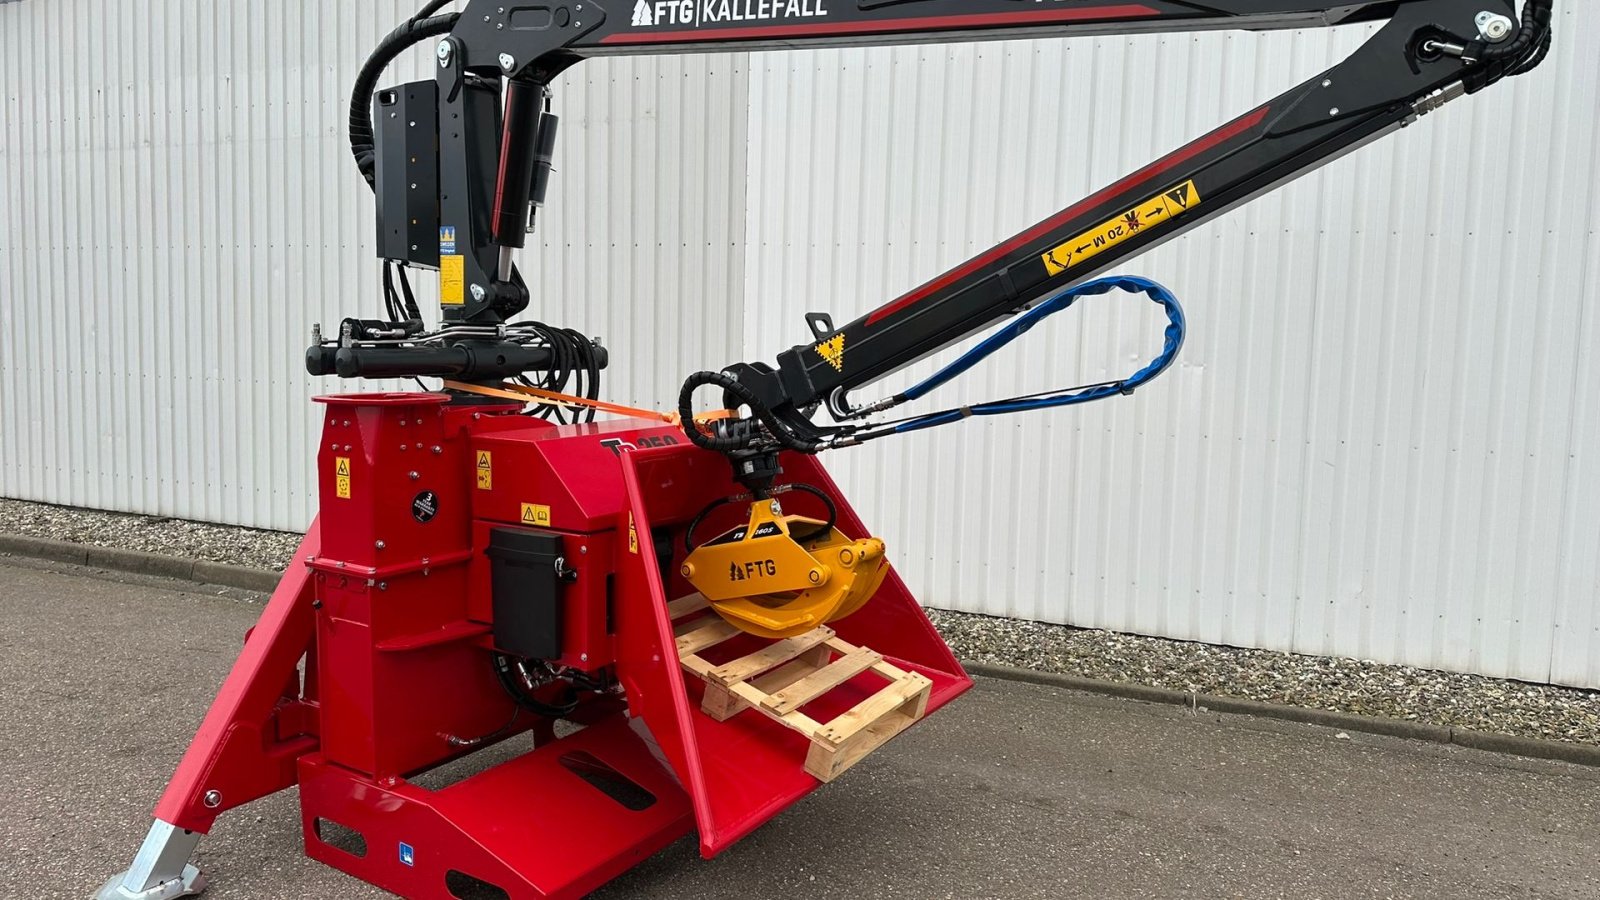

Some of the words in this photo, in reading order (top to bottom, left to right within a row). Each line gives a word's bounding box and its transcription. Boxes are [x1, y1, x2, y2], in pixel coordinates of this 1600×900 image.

[654, 0, 693, 25] FTG
[702, 0, 828, 23] KALLEFALL
[1108, 225, 1124, 240] 20
[1092, 235, 1106, 248] M
[426, 492, 432, 501] 3
[744, 559, 776, 579] FTG
